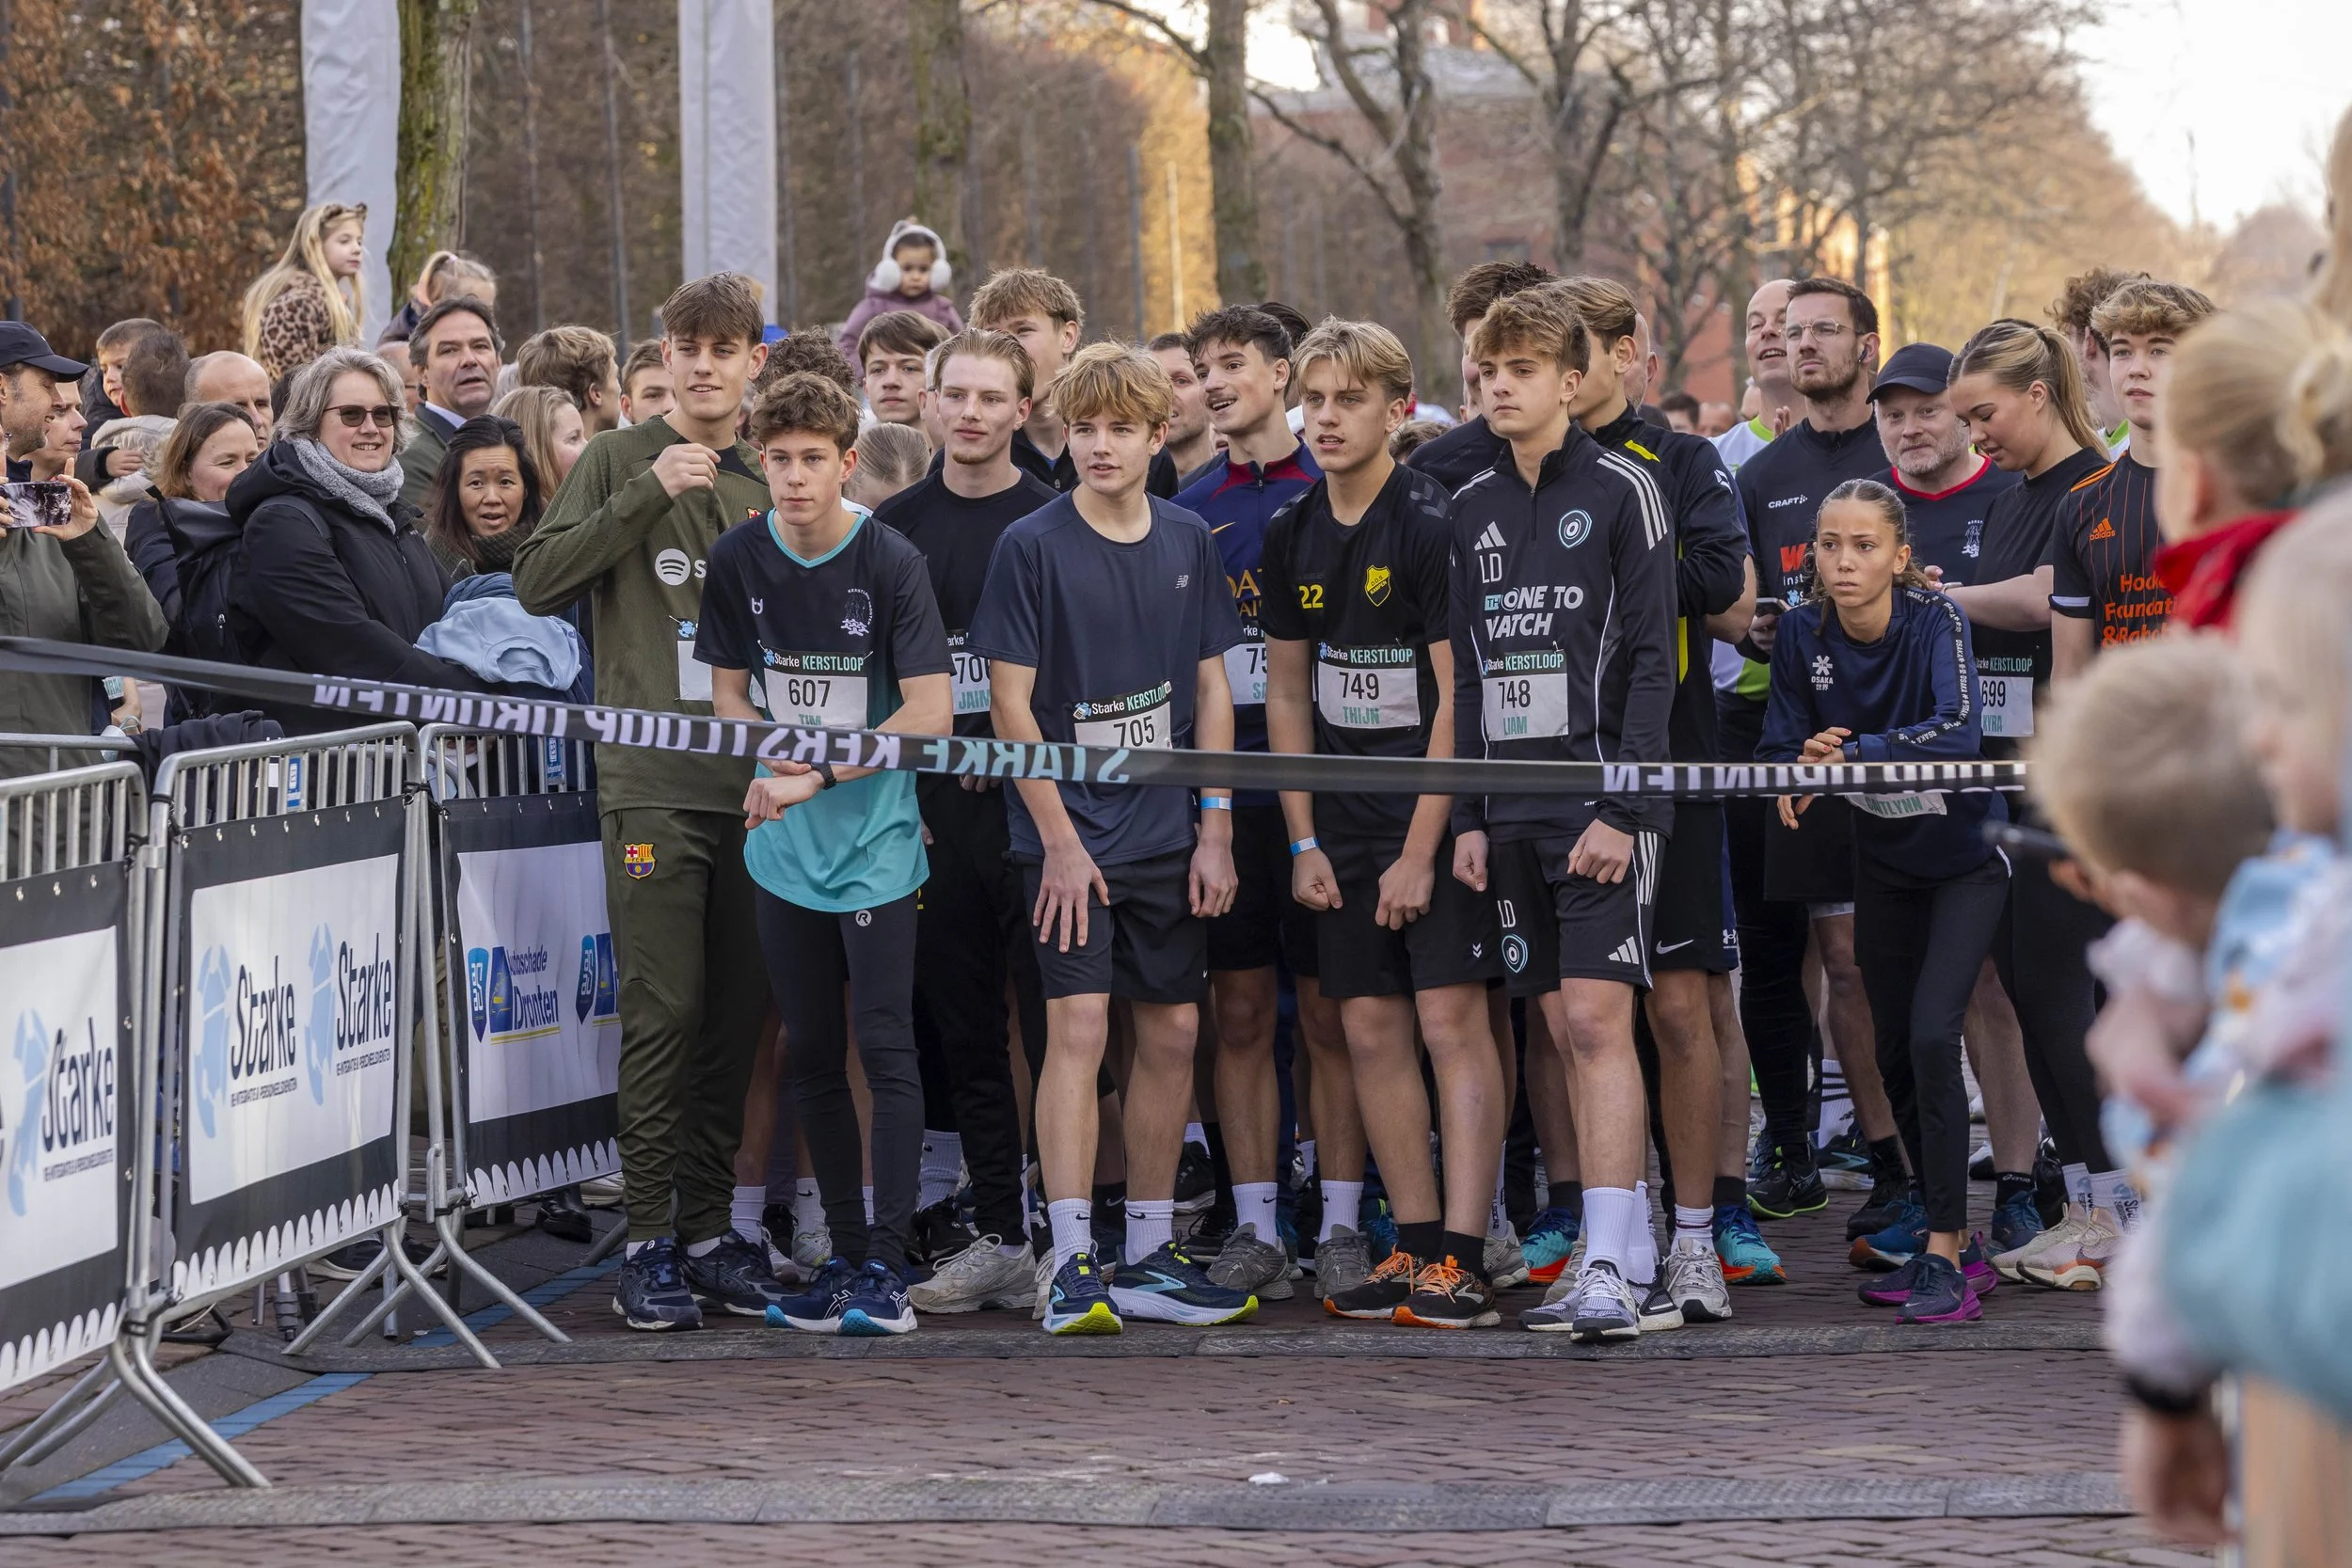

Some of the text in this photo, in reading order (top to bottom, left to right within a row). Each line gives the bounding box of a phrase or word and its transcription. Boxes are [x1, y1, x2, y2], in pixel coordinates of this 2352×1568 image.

[1769, 497, 1799, 509] CRAFT
[2090, 530, 2116, 541] adidas
[1479, 553, 1502, 583] LD
[1298, 584, 1324, 610] 22
[1504, 586, 1548, 611] ONE
[1554, 586, 1583, 610] TO
[774, 652, 864, 672] Starke KERSTLOOP
[1327, 647, 1413, 664] Starke KERSTLOOP
[1505, 654, 1564, 671] KERSTLOOP
[1990, 657, 2033, 673] KERSTLOOP
[1339, 672, 1379, 700] 749
[1811, 675, 1834, 684] OSAKA
[788, 678, 831, 708] 607
[1498, 679, 1531, 709] 748
[1982, 680, 2006, 707] 699
[1091, 701, 1125, 716] Starke
[1343, 705, 1380, 725] THIJN
[1113, 715, 1155, 748] 705
[1502, 715, 1529, 736] LIAM
[1983, 715, 2003, 733] KYRA
[1497, 899, 1517, 928] LD
[337, 932, 392, 1051] Starke
[231, 955, 297, 1080] Starke
[514, 985, 559, 1031] Dronten
[42, 1016, 114, 1152] Starke
